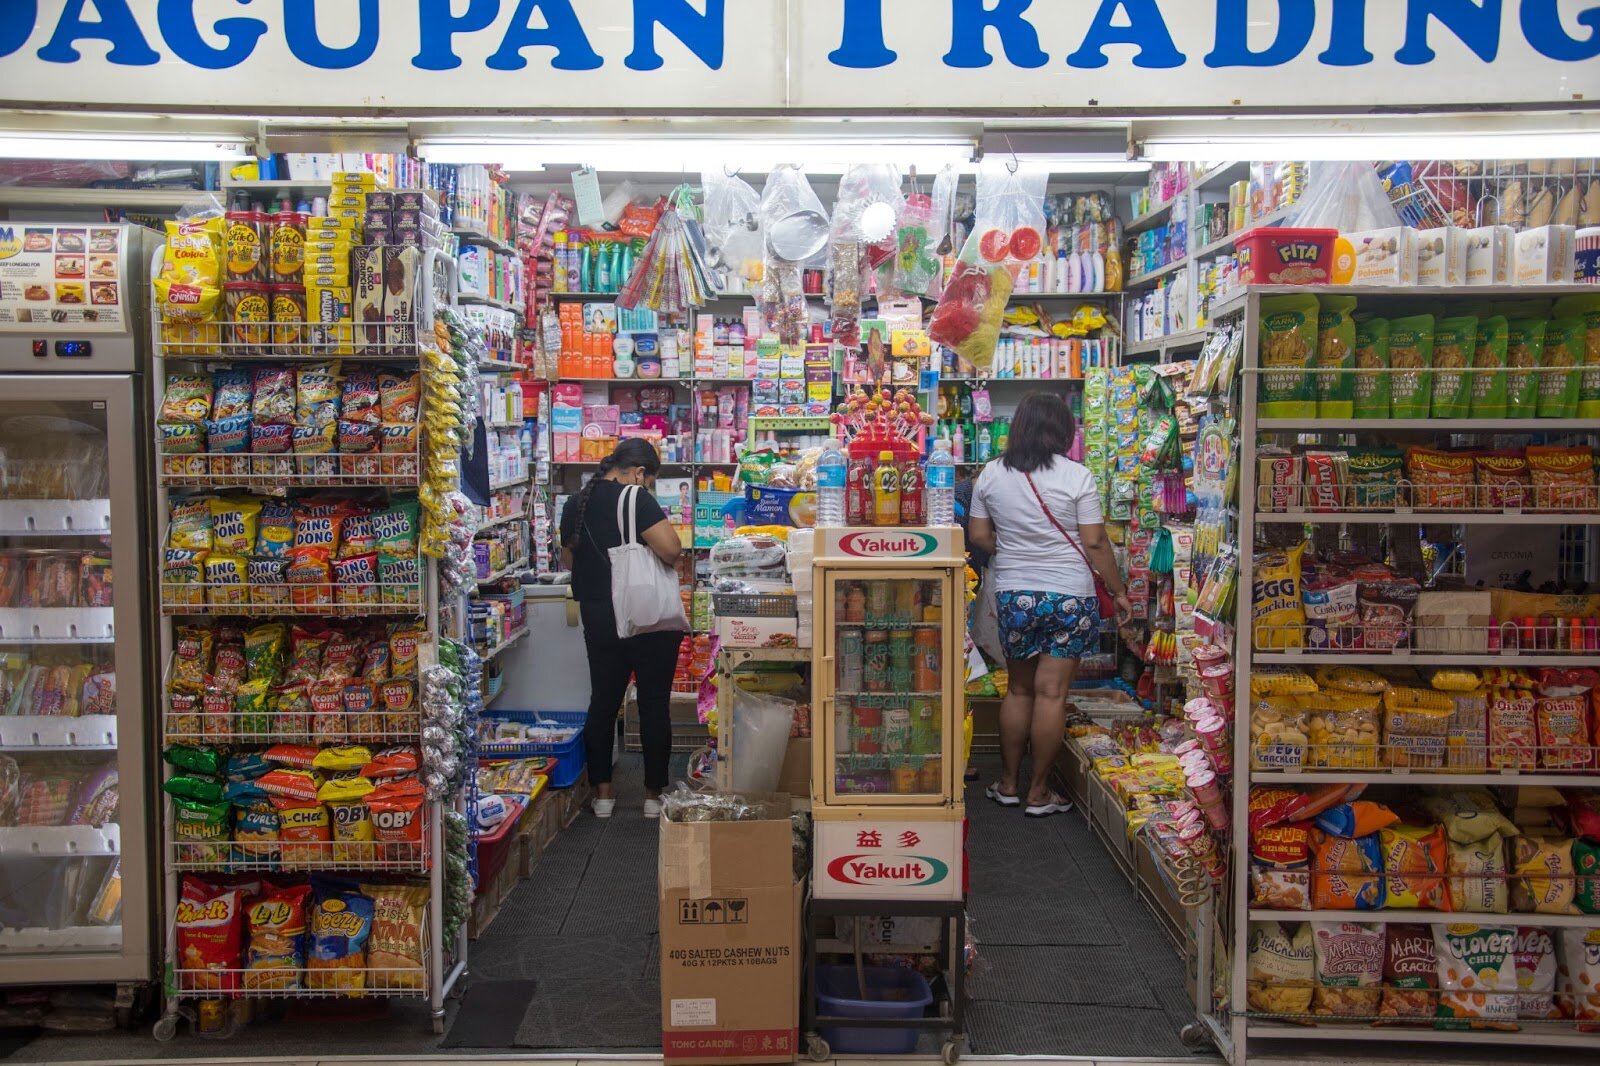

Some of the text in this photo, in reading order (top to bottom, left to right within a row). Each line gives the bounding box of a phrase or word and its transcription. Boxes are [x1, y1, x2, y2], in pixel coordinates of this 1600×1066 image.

[229, 230, 255, 242] Stik-O
[275, 231, 300, 244] Stik-O
[1279, 243, 1318, 263] FITA
[208, 419, 248, 436] BOY
[252, 425, 288, 439] BOY
[292, 426, 324, 439] BOY
[881, 472, 897, 493] C2
[901, 473, 917, 492] C2
[754, 504, 783, 512] Mamon
[213, 512, 243, 526] DING
[299, 519, 331, 532] DING
[374, 511, 405, 528] DING
[375, 522, 410, 540] DONG
[297, 531, 333, 545] DONG
[857, 538, 920, 552] Yakult
[165, 549, 197, 560] BOY
[1490, 551, 1534, 560] CARONIA
[205, 562, 236, 575] DING
[248, 561, 280, 575] DING
[335, 559, 368, 578] DING
[384, 560, 414, 575] DING
[1252, 579, 1295, 604] EGG
[393, 638, 418, 647] CORN
[316, 694, 339, 702] CORN
[345, 693, 369, 701] CORN
[384, 687, 409, 696] CORN
[349, 700, 366, 708] BITS
[1496, 701, 1528, 712] Oishi
[1544, 702, 1575, 712] Oishi
[247, 813, 278, 825] CURLS
[856, 829, 921, 848] 益多
[850, 862, 926, 879] Yakult
[1342, 923, 1362, 934] Oishi
[1450, 933, 1513, 959] CLOVER
[669, 946, 790, 960] 40G SALTED CASHEW NUTS
[1468, 955, 1504, 964] CHIPS
[682, 959, 698, 967] 40G
[700, 959, 705, 967] X
[708, 958, 737, 967] 12PKTS
[746, 957, 778, 966] 10BAGS
[672, 1039, 735, 1049] TONG GARDEN
